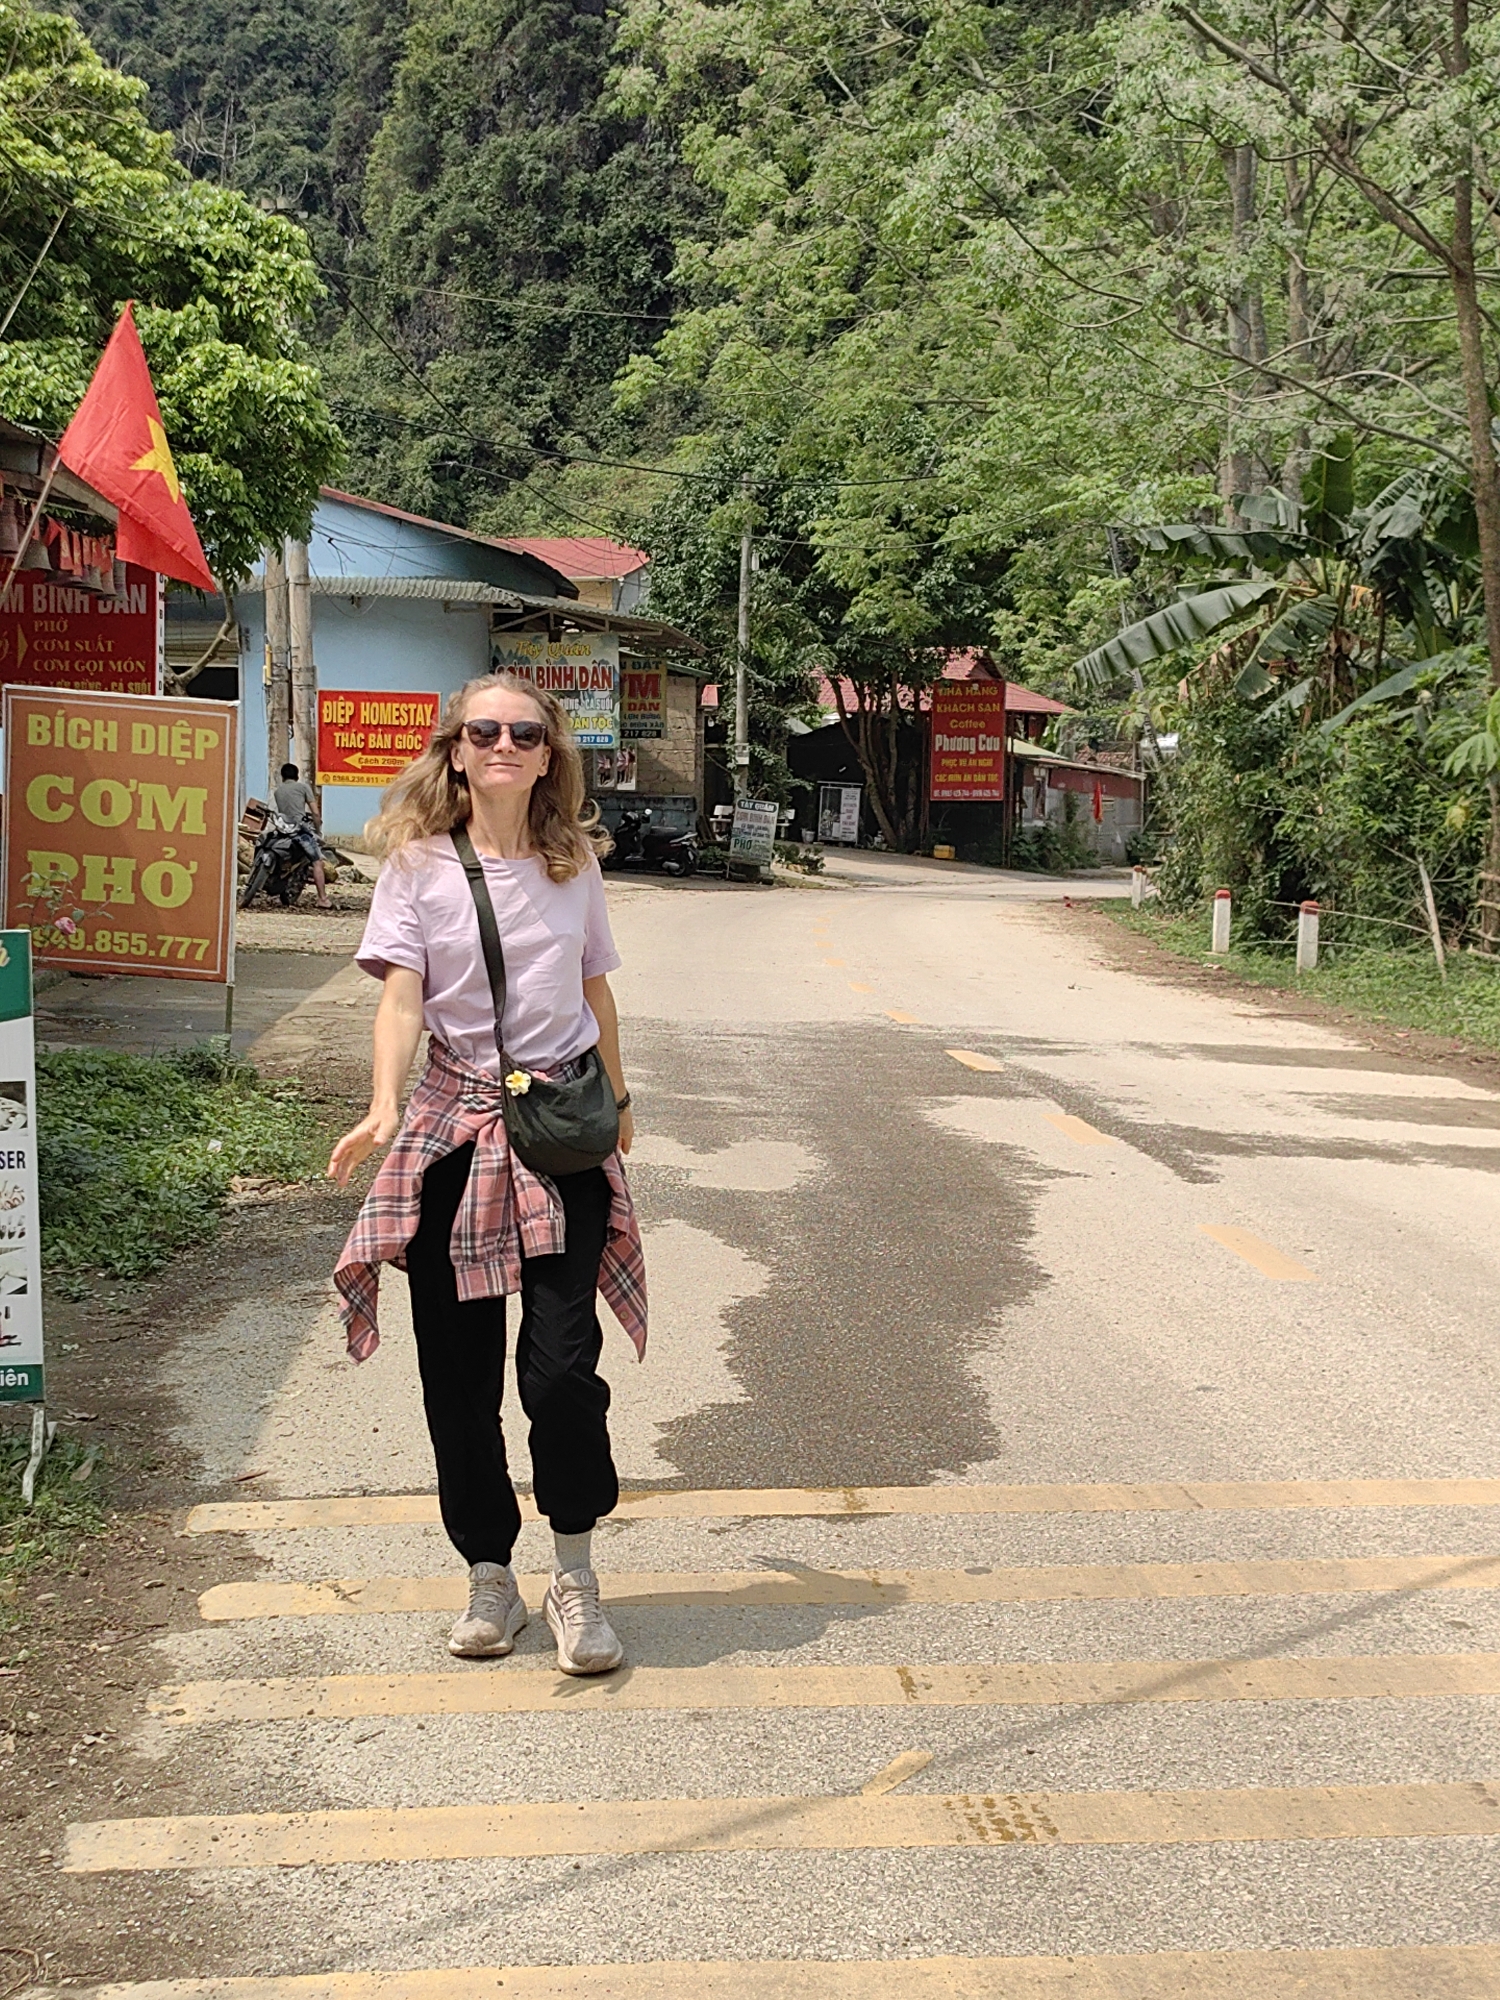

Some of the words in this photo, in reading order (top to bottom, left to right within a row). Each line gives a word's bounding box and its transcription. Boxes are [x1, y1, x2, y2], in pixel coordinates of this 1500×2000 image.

[578, 659, 614, 691] DÂN
[322, 695, 355, 728] ĐIỆP
[360, 702, 434, 727] HOMESTAY
[949, 718, 986, 729] Coffee
[27, 709, 118, 753] BÍCH
[131, 719, 220, 766] DIỆP
[333, 729, 365, 749] THÁC
[395, 728, 423, 750] GIỐC
[26, 773, 209, 836] CƠM
[26, 846, 199, 909] PHỞ
[16, 923, 210, 961] 949.855.777
